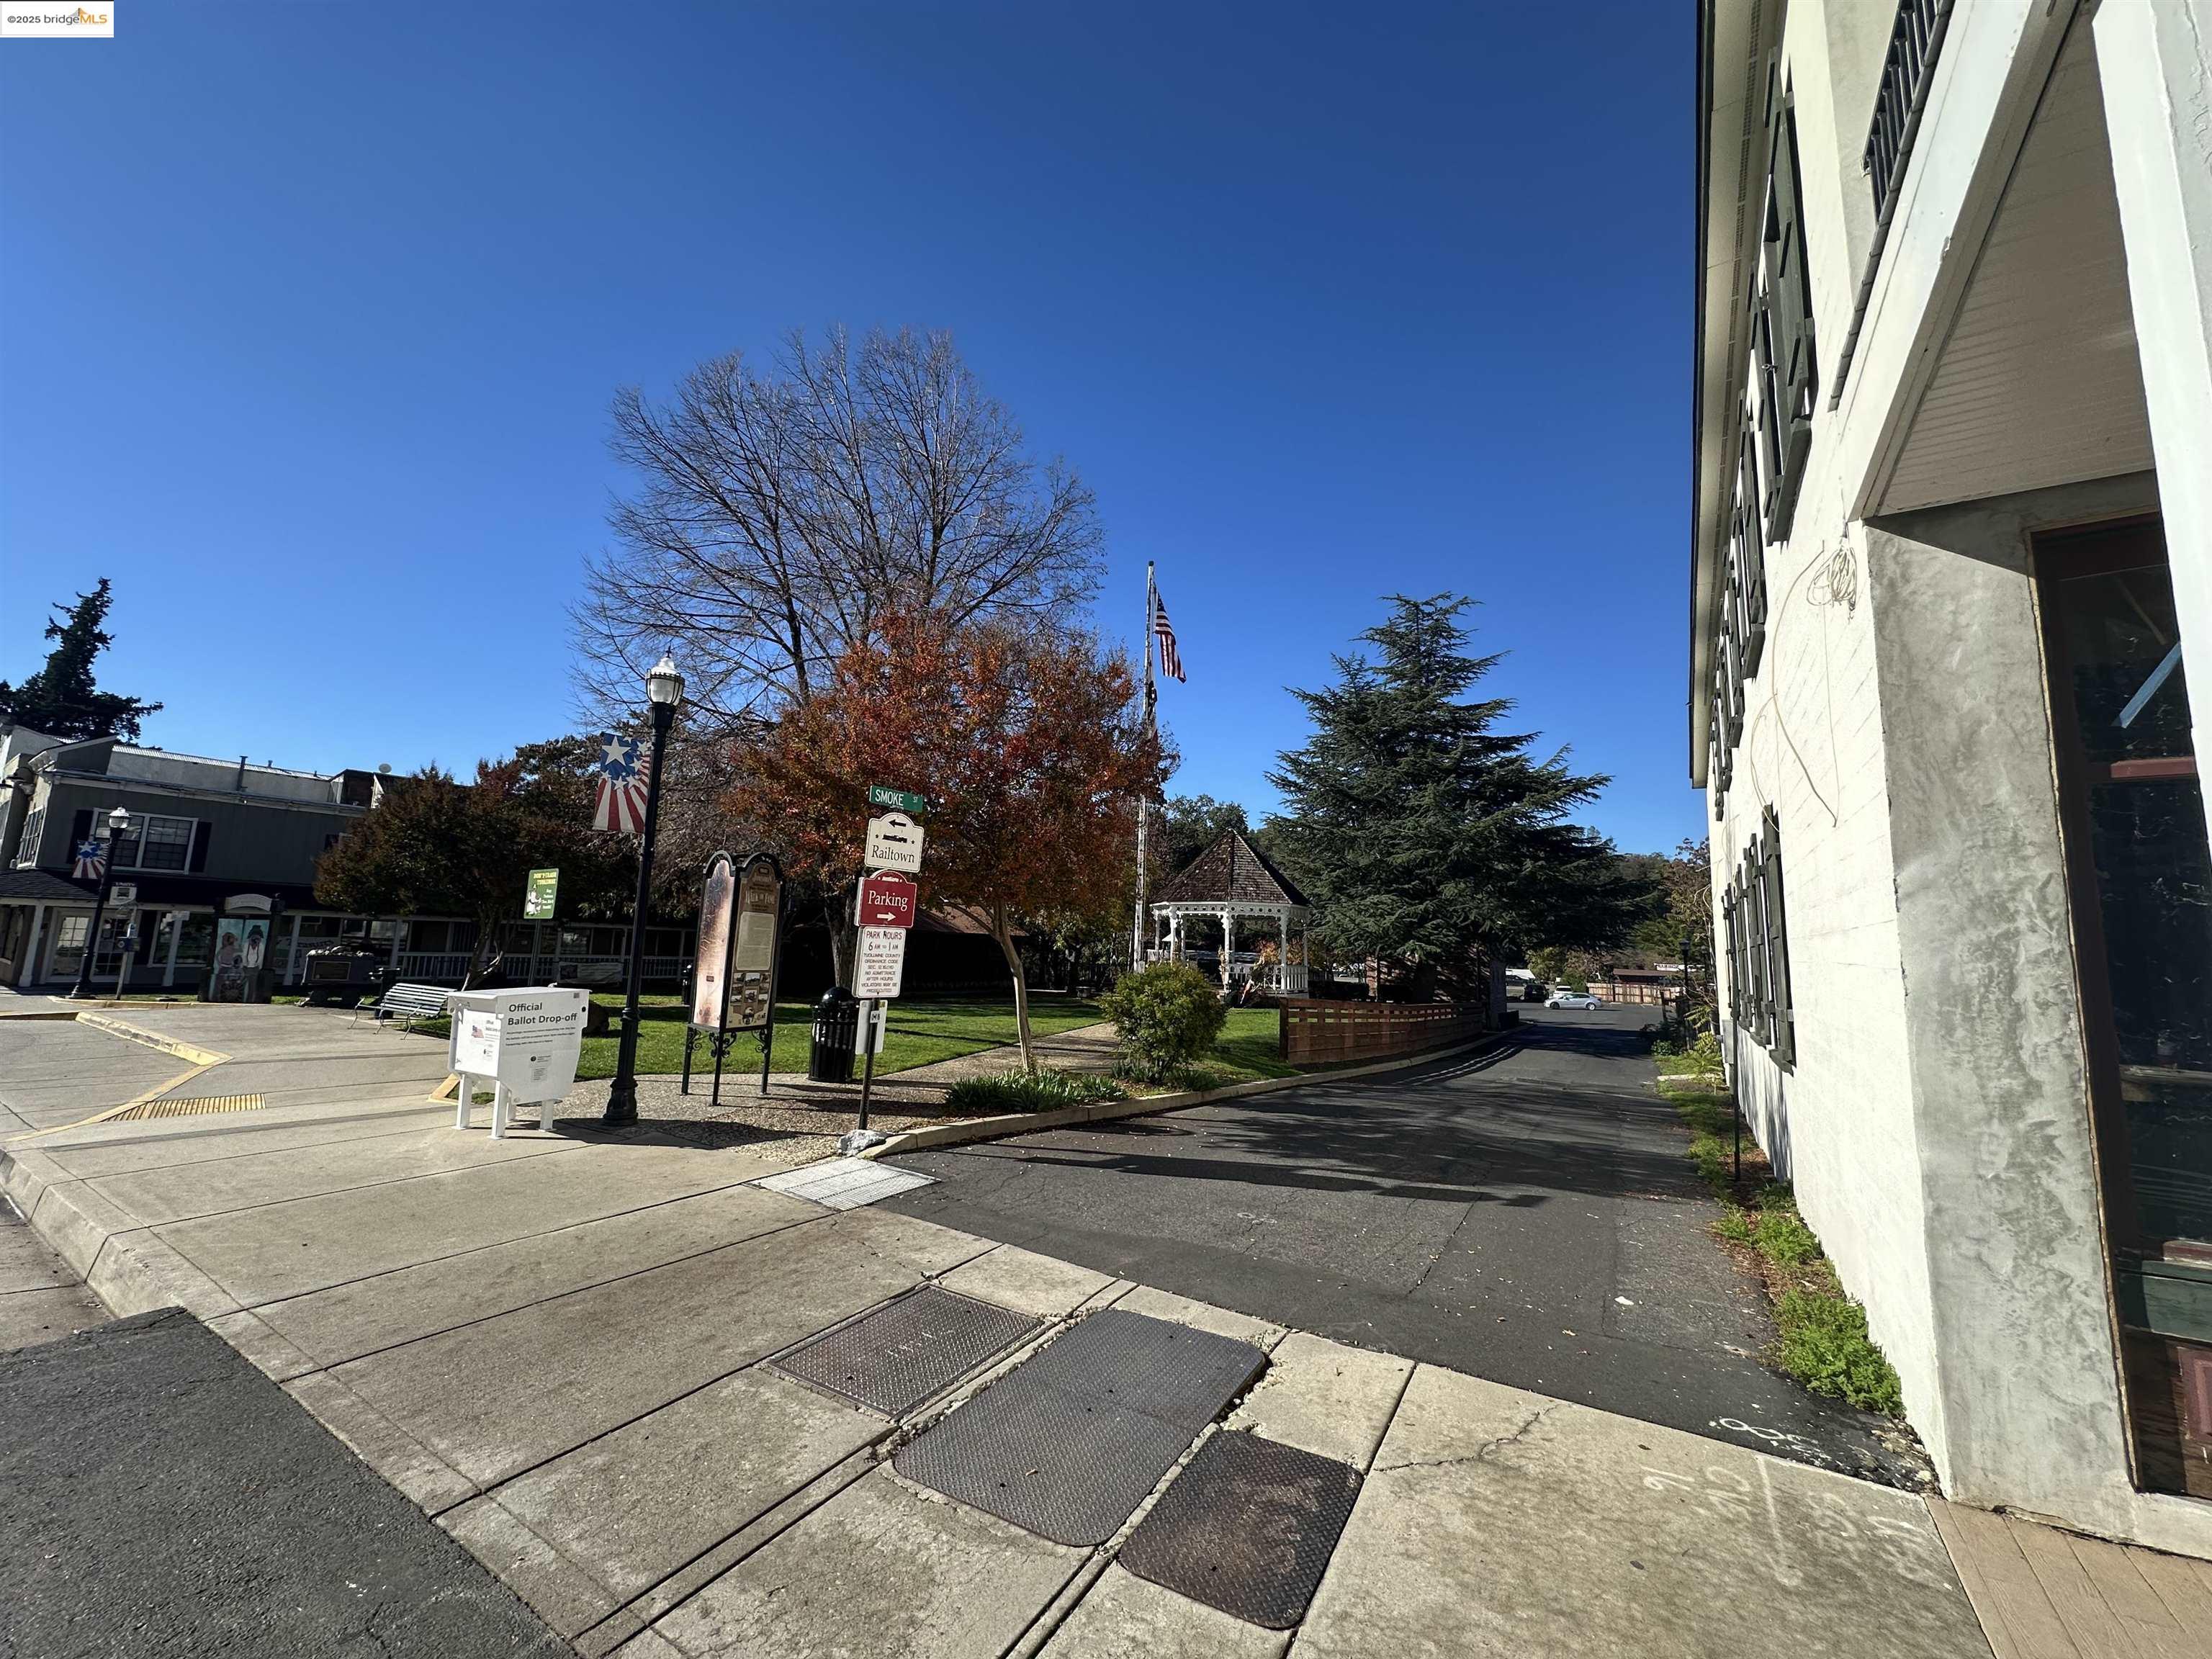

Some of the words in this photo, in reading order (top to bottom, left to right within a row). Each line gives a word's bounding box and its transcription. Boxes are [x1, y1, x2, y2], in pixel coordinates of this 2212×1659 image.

[875, 789, 904, 806] SMOKE
[871, 845, 914, 863] Railtown
[868, 890, 908, 912] Parking
[866, 930, 881, 939] PARK
[883, 930, 902, 940] HOURS
[868, 941, 873, 951] 6
[508, 1002, 542, 1012] Official
[508, 1016, 536, 1025] Ballot
[539, 1012, 577, 1023] Drop-off
